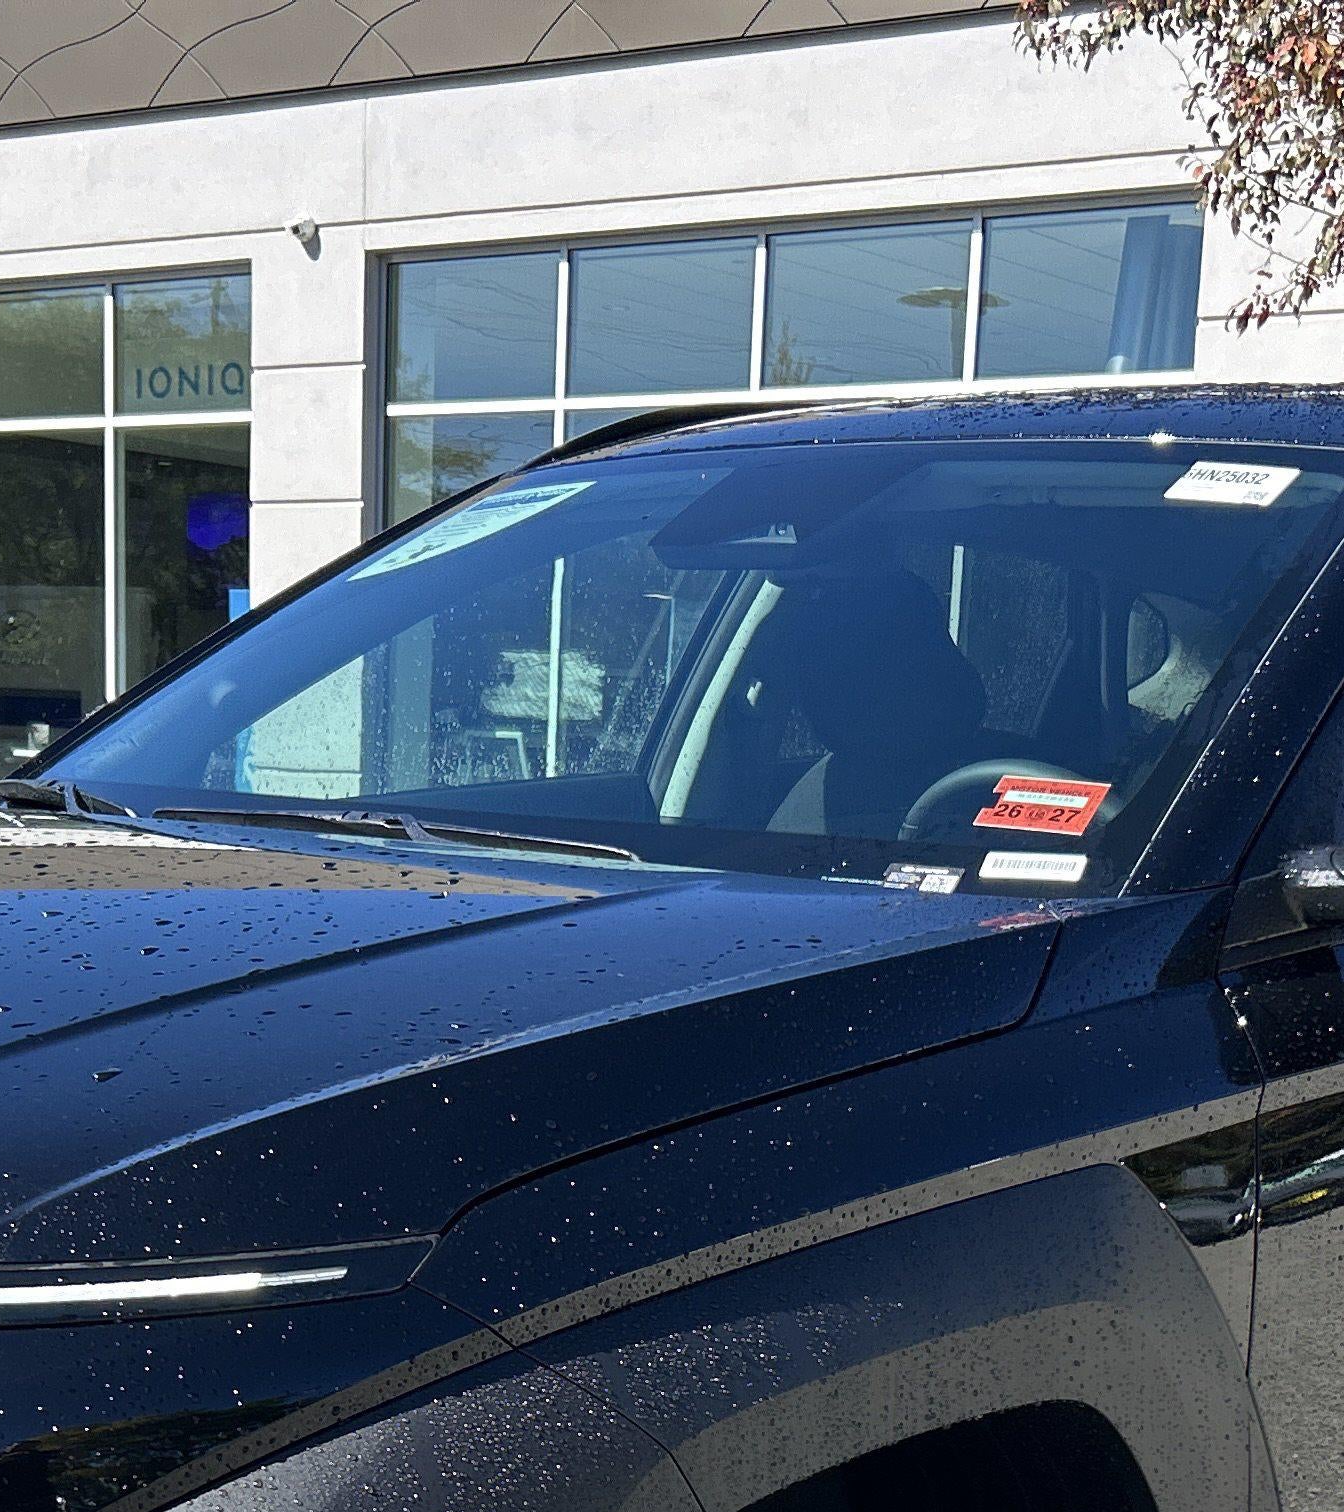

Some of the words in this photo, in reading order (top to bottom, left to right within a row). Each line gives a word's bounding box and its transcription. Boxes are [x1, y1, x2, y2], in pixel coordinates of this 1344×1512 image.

[136, 361, 245, 399] IONIQ
[993, 803, 1024, 818] 26
[1048, 808, 1082, 824] 27
